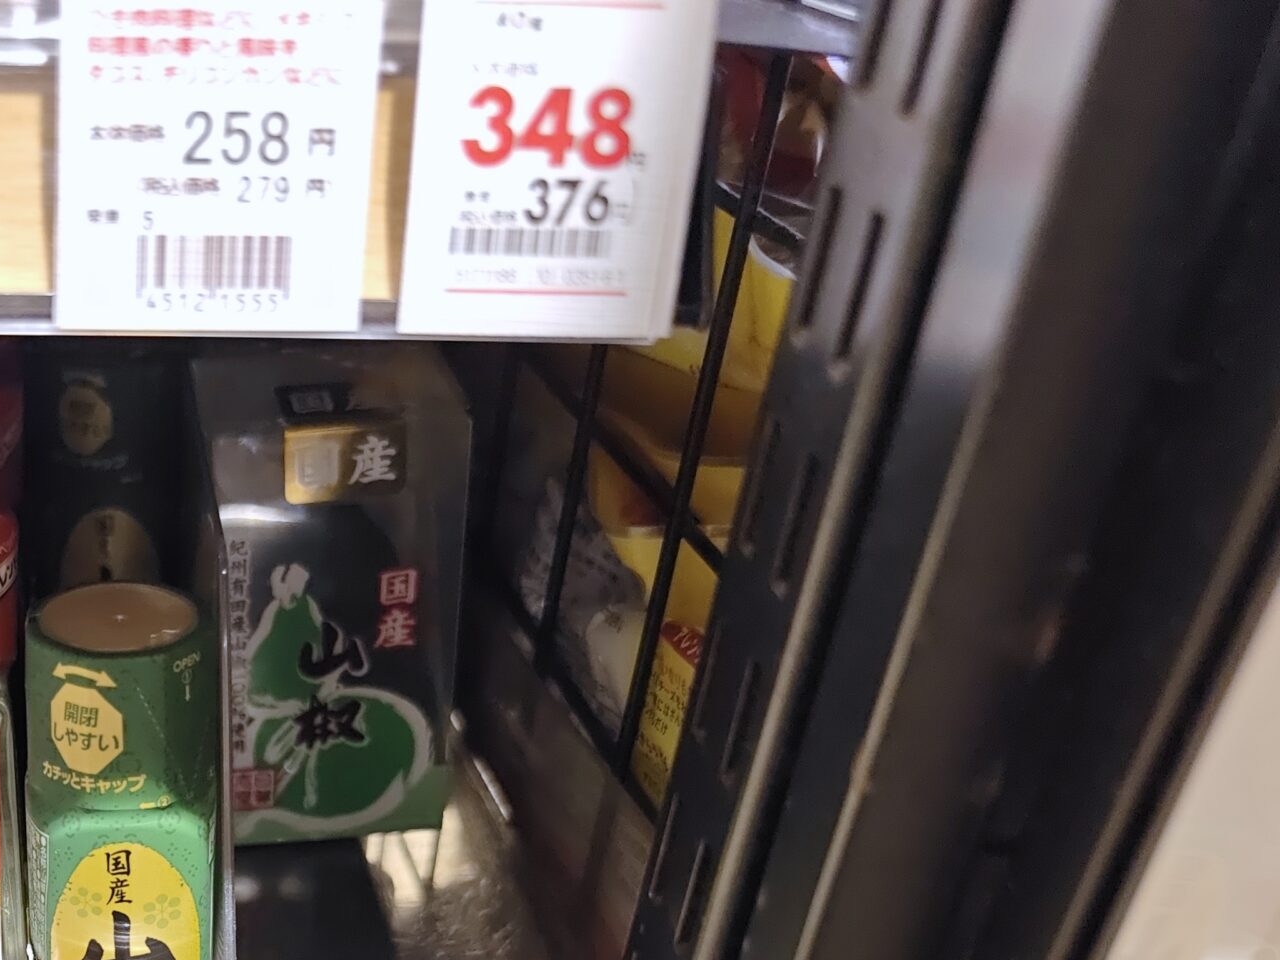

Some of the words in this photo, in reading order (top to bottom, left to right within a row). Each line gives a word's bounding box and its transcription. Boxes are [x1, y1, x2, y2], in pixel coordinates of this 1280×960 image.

[182, 110, 289, 165] 258
[460, 85, 633, 169] 348
[236, 176, 290, 203] 279
[523, 178, 610, 226] 376
[373, 567, 419, 650] 国産
[296, 619, 370, 750] 山椒
[53, 721, 120, 752] しやすい
[63, 701, 99, 728] 開閉
[42, 760, 147, 794] カチッとキャップ
[105, 849, 133, 905] 国産
